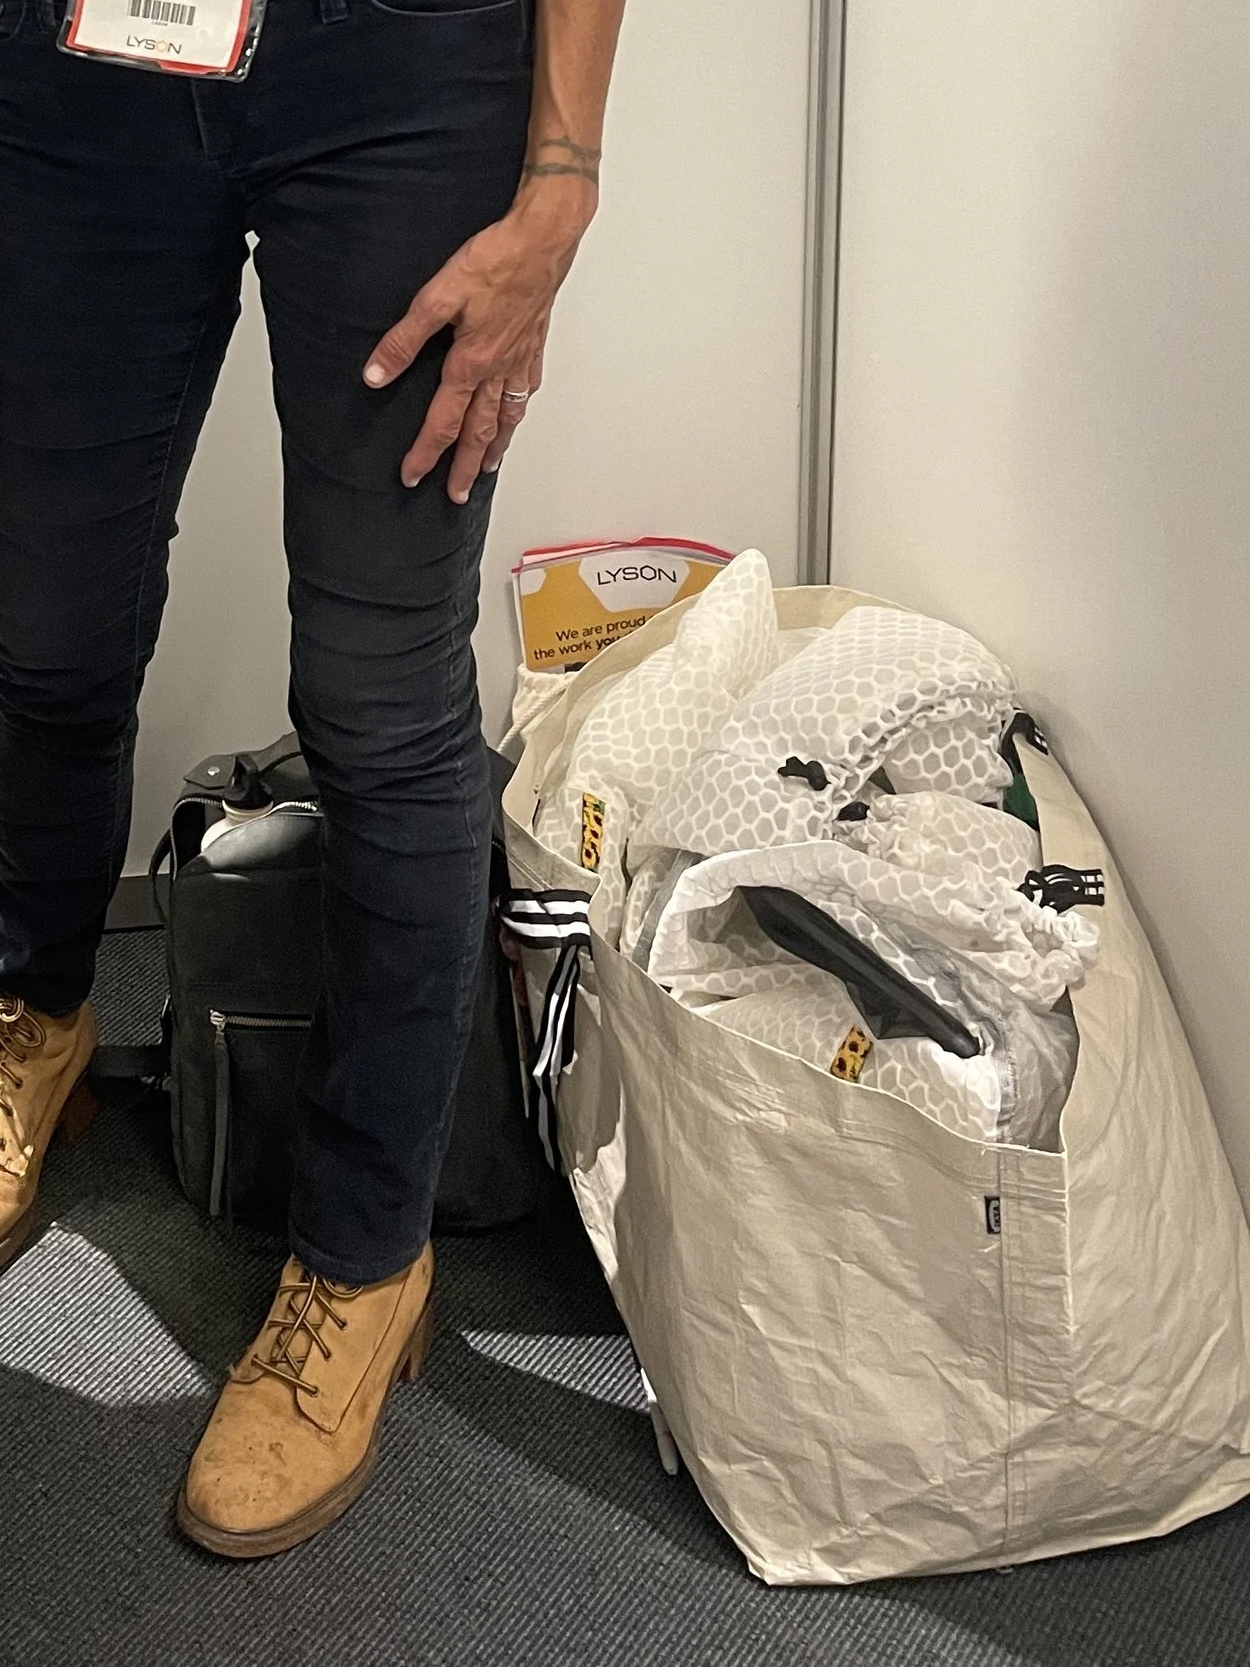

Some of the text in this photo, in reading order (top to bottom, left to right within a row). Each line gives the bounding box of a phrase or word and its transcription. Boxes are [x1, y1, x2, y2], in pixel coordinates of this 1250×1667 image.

[126, 36, 182, 55] LYSON
[597, 565, 677, 585] LYSON
[556, 629, 578, 641] We
[582, 625, 602, 637] are
[606, 616, 646, 634] proud
[534, 648, 555, 660] the
[558, 640, 592, 654] work
